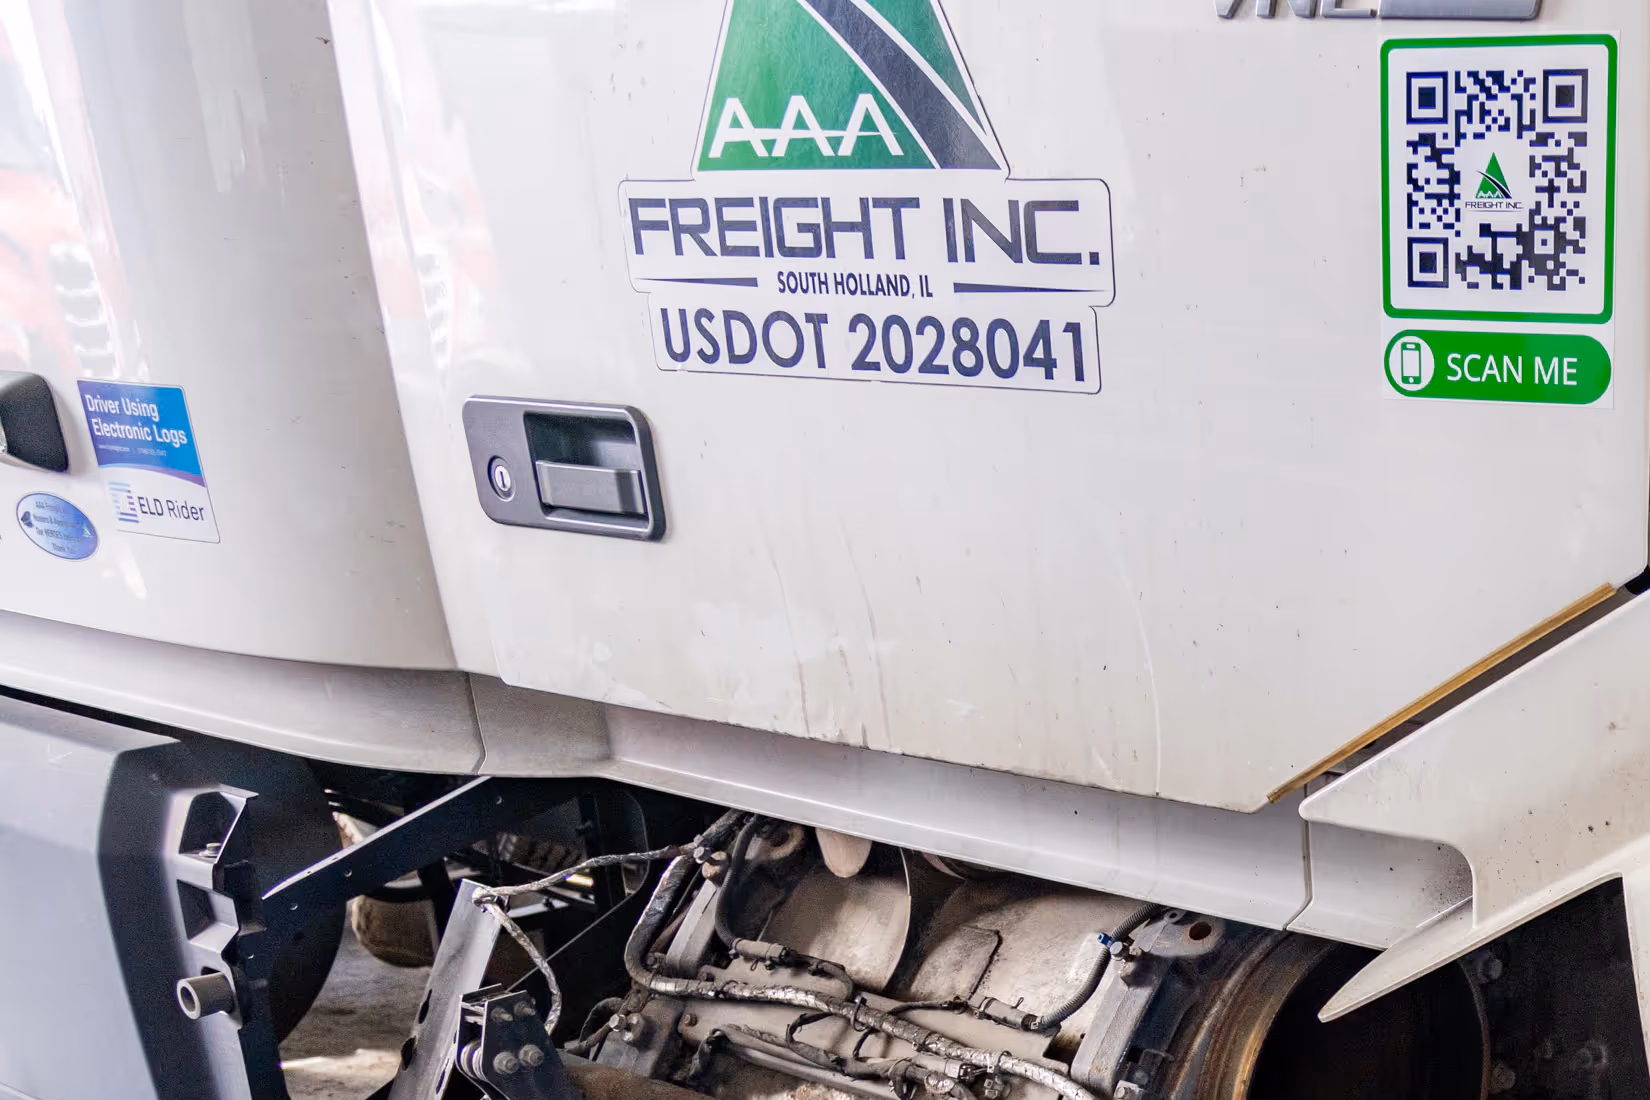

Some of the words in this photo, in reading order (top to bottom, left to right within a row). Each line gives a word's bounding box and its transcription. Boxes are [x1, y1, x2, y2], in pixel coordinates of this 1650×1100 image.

[708, 93, 904, 158] AAA
[1465, 201, 1504, 209] FREIGHT
[629, 196, 920, 259] FREIGHT
[943, 197, 1101, 266] INC.
[777, 270, 830, 295] SOUTH
[833, 272, 914, 299] HOLLAND,
[919, 274, 934, 298] IL
[660, 307, 829, 370] USDOT
[848, 312, 1085, 382] 2028041
[1446, 353, 1523, 384] SCAN
[1534, 356, 1578, 386] ME
[85, 394, 120, 414] Driver
[121, 398, 160, 422] Using
[91, 417, 152, 442] Electronic
[153, 424, 188, 448] Logs
[138, 495, 164, 517] ELD
[167, 500, 205, 521] Rider
